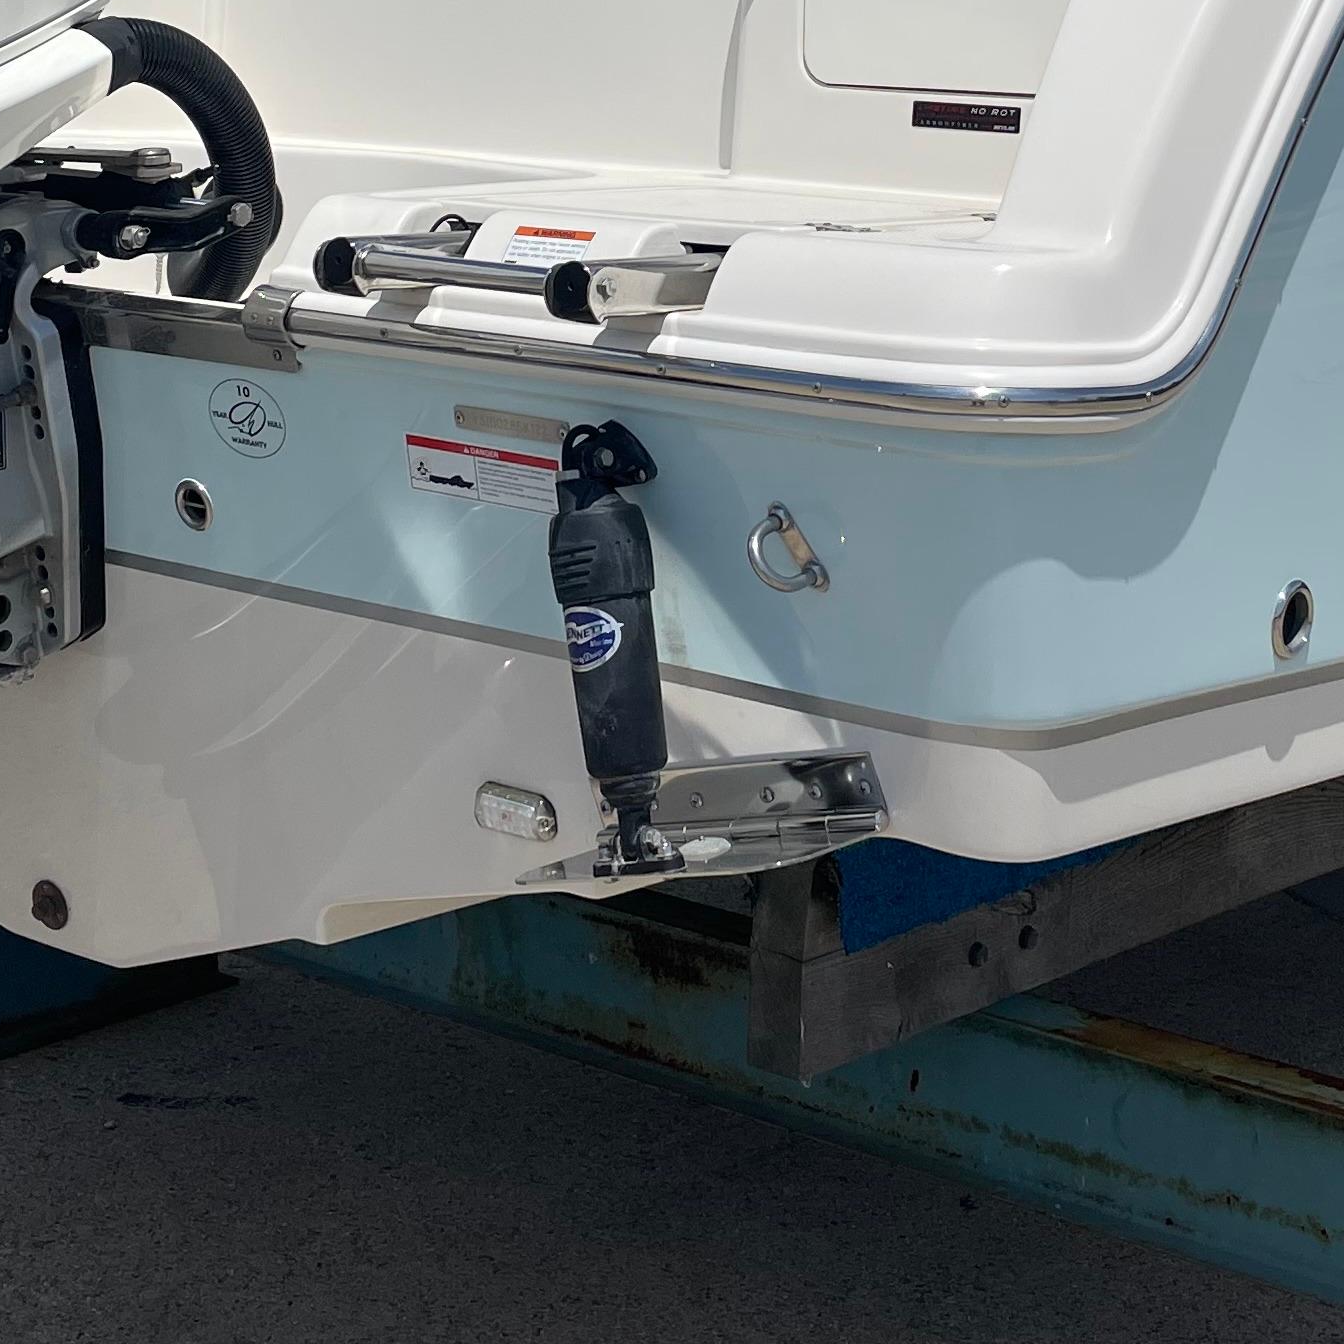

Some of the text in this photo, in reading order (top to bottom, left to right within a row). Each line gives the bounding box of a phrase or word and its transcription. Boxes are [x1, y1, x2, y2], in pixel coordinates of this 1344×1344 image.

[991, 108, 1016, 117] ROT
[236, 385, 250, 397] 10
[232, 437, 267, 449] WARRANTY
